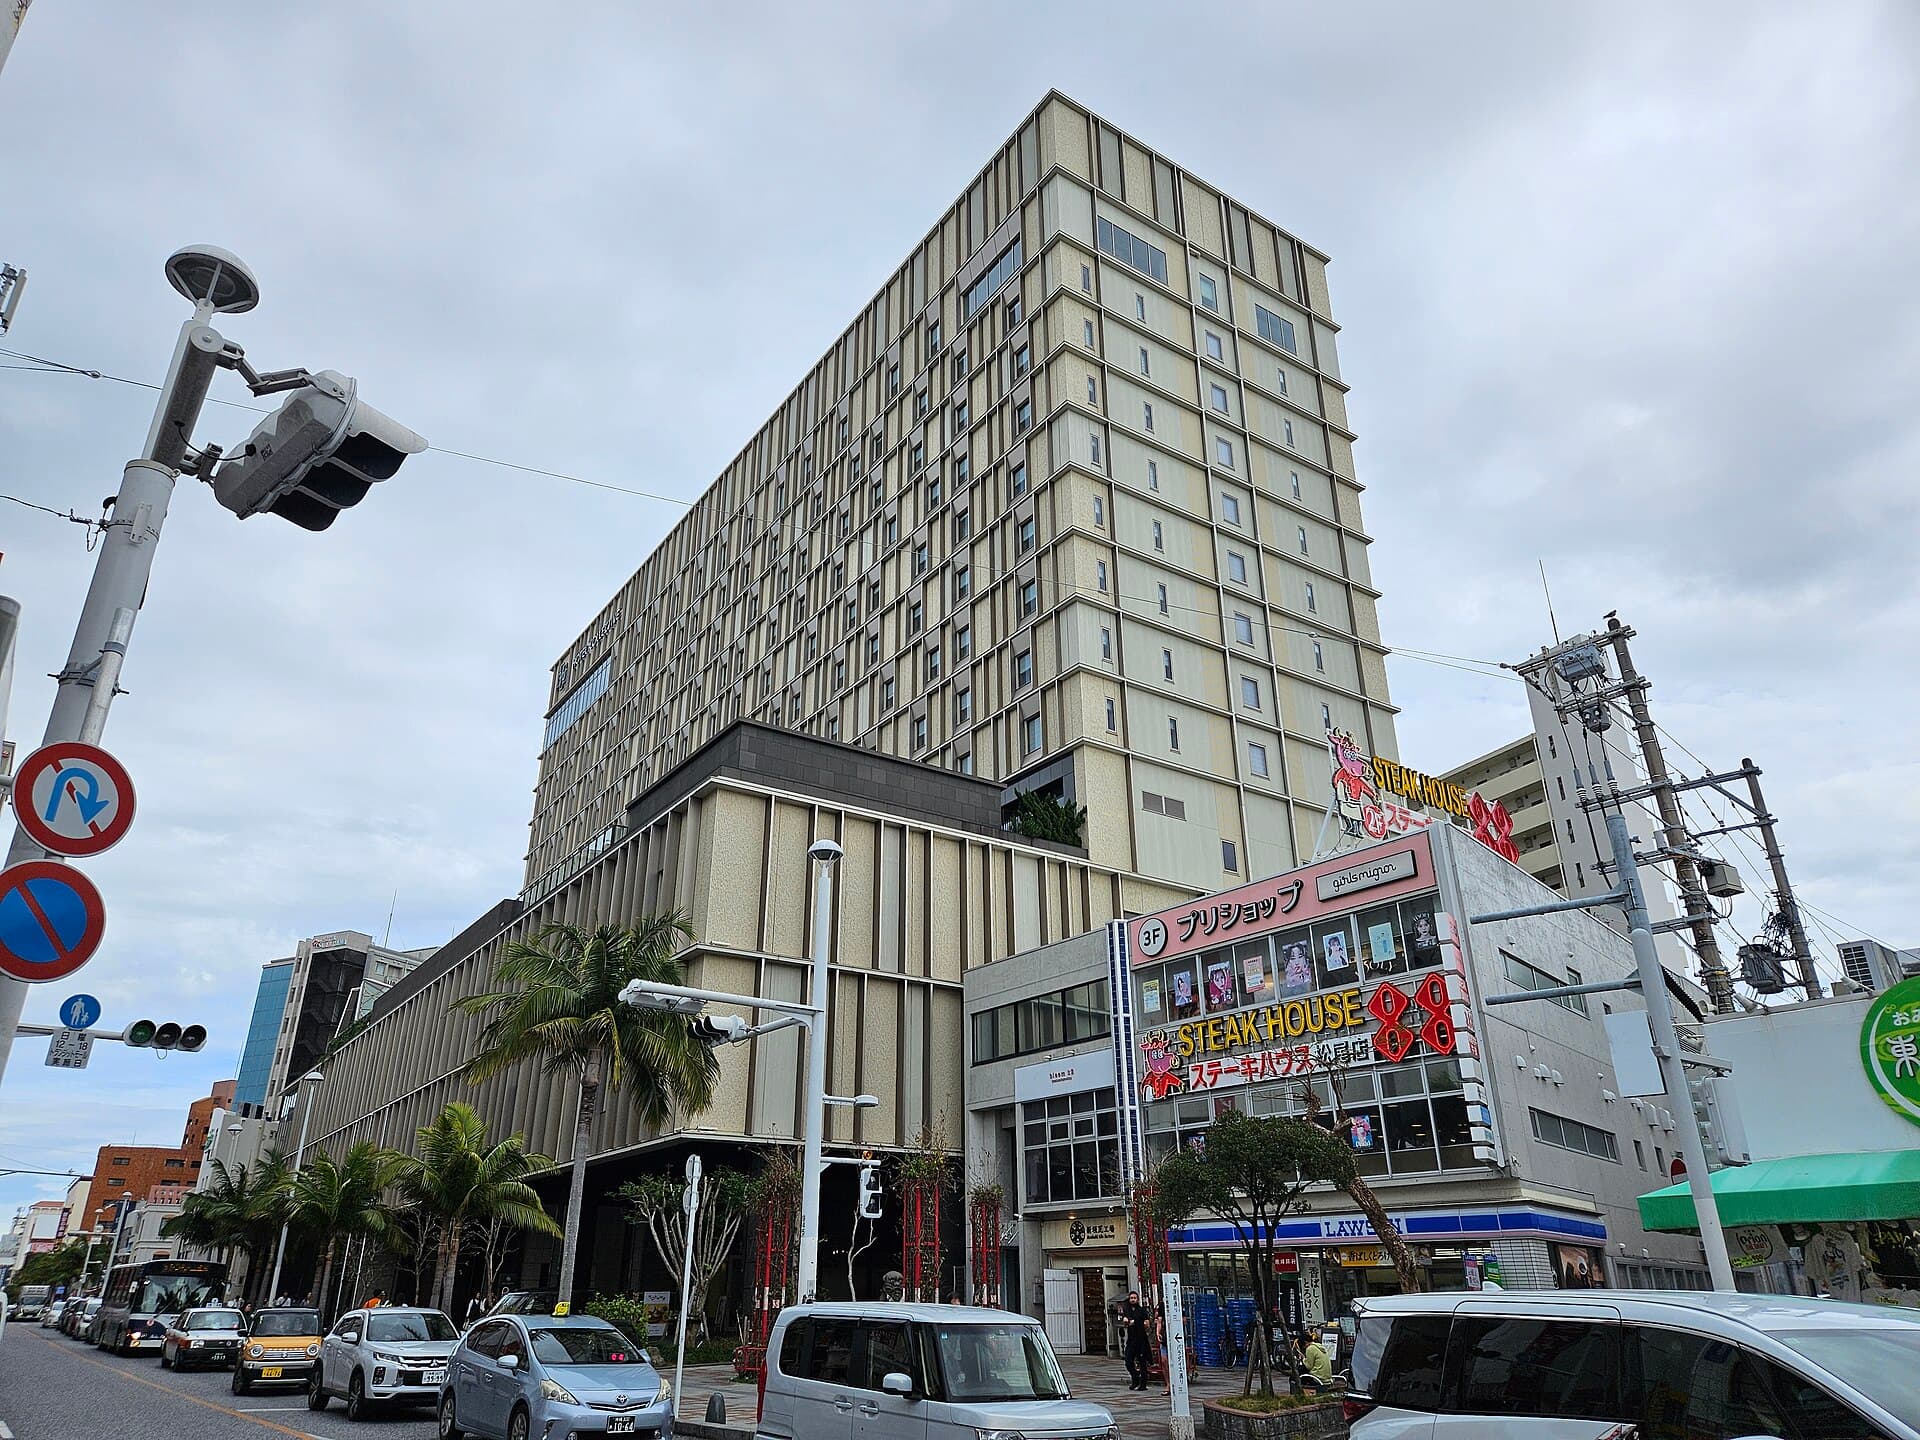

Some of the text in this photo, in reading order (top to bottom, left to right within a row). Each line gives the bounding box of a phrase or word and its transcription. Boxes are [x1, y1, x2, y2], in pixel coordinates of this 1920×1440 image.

[1372, 755, 1471, 818] STEAK HOUSE
[1384, 802, 1434, 832] ステー
[1143, 879, 1304, 948] 3F プリショップ
[1178, 988, 1366, 1058] STEAK HOUSE
[1367, 972, 1457, 1064] 88
[1191, 1045, 1315, 1090] ステーキハウス
[1325, 1218, 1403, 1237] LAWSN
